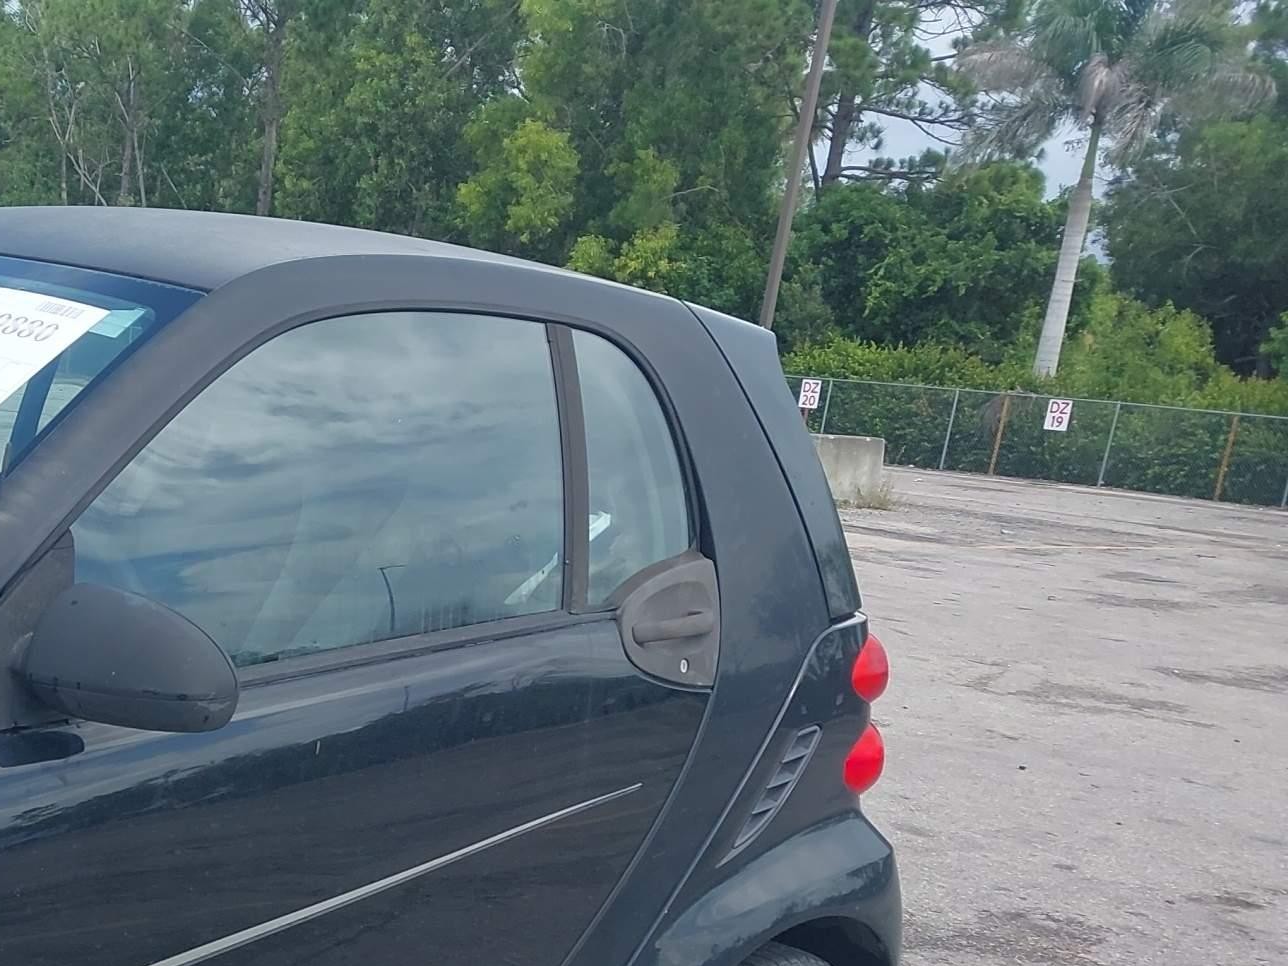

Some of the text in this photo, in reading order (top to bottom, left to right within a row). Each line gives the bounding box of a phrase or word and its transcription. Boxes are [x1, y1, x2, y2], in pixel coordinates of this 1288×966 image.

[803, 382, 820, 394] DZ
[801, 394, 816, 406] 20
[1049, 402, 1071, 414] DZ
[1051, 415, 1064, 428] 19
